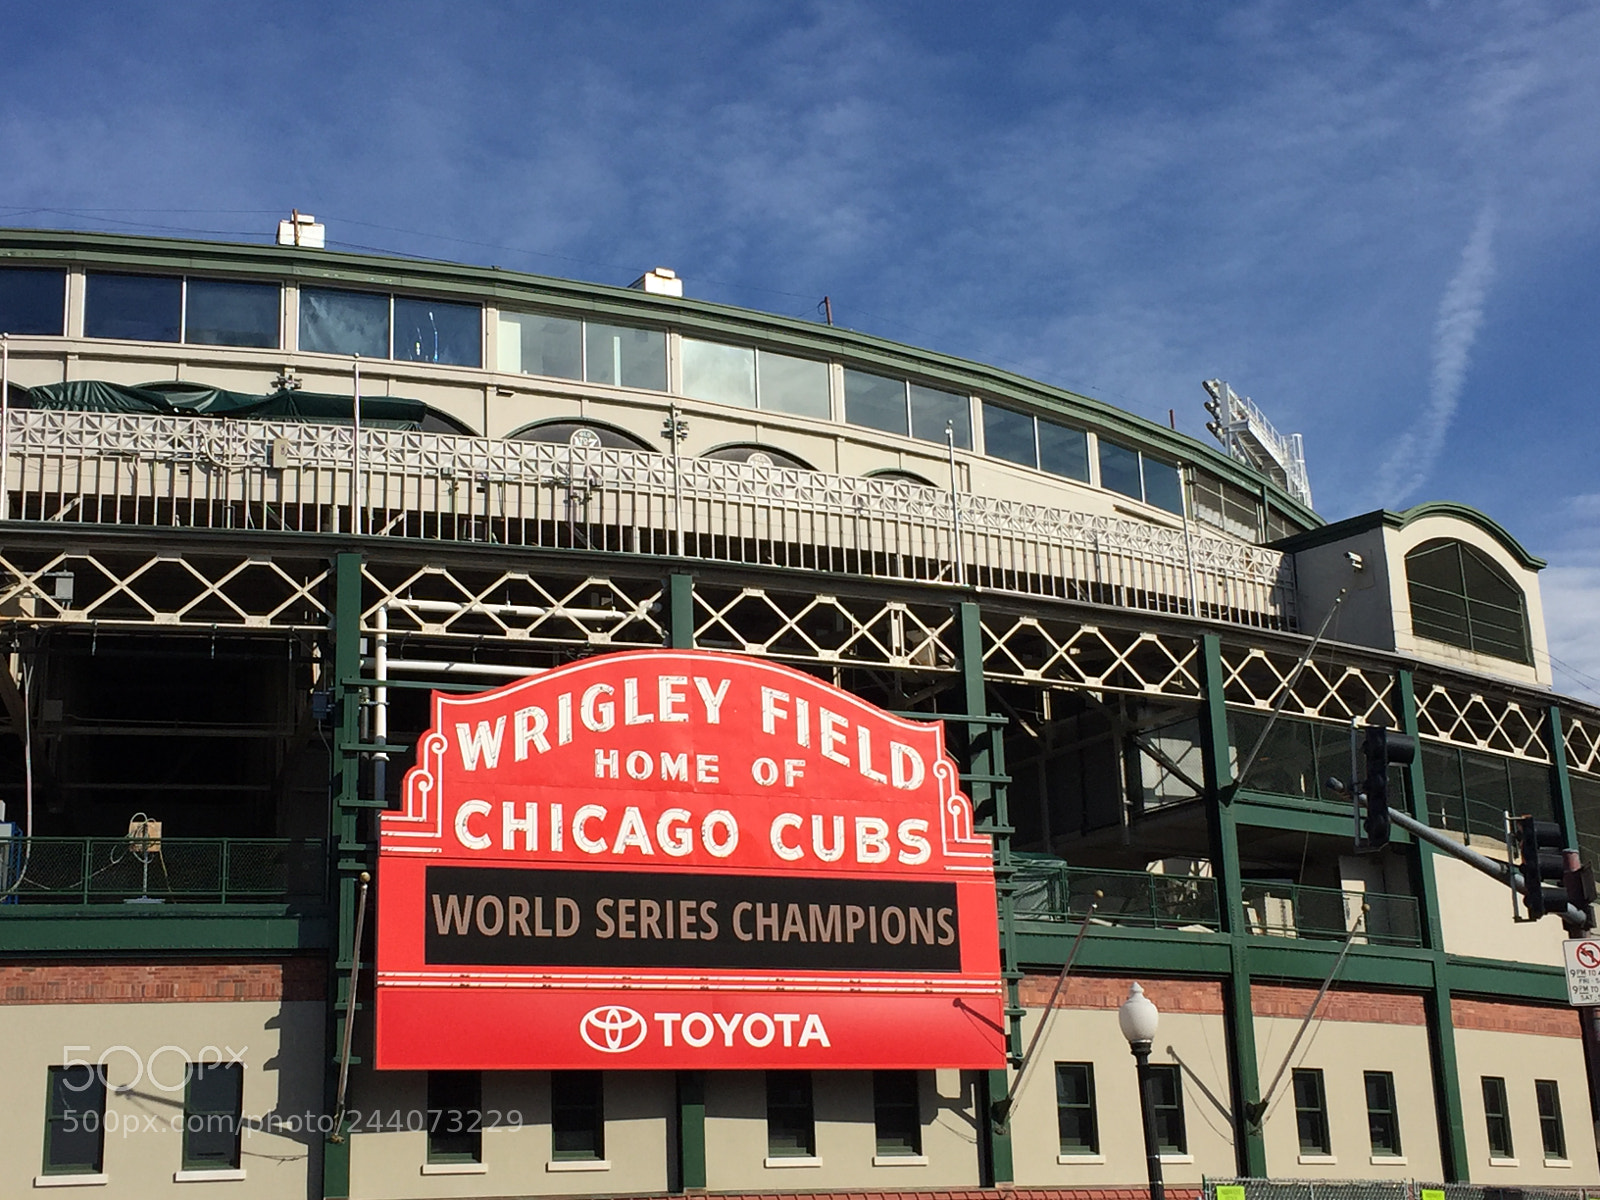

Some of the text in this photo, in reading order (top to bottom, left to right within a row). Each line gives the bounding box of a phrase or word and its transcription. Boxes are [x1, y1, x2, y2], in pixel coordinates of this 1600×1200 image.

[455, 675, 927, 791] WRIGLEY FIELD
[594, 748, 806, 788] HOME OF
[454, 799, 932, 866] CHICAGO CUBS
[431, 894, 955, 946] WORLD SERIES CHAMPIONS
[654, 1012, 831, 1048] TOYOTA
